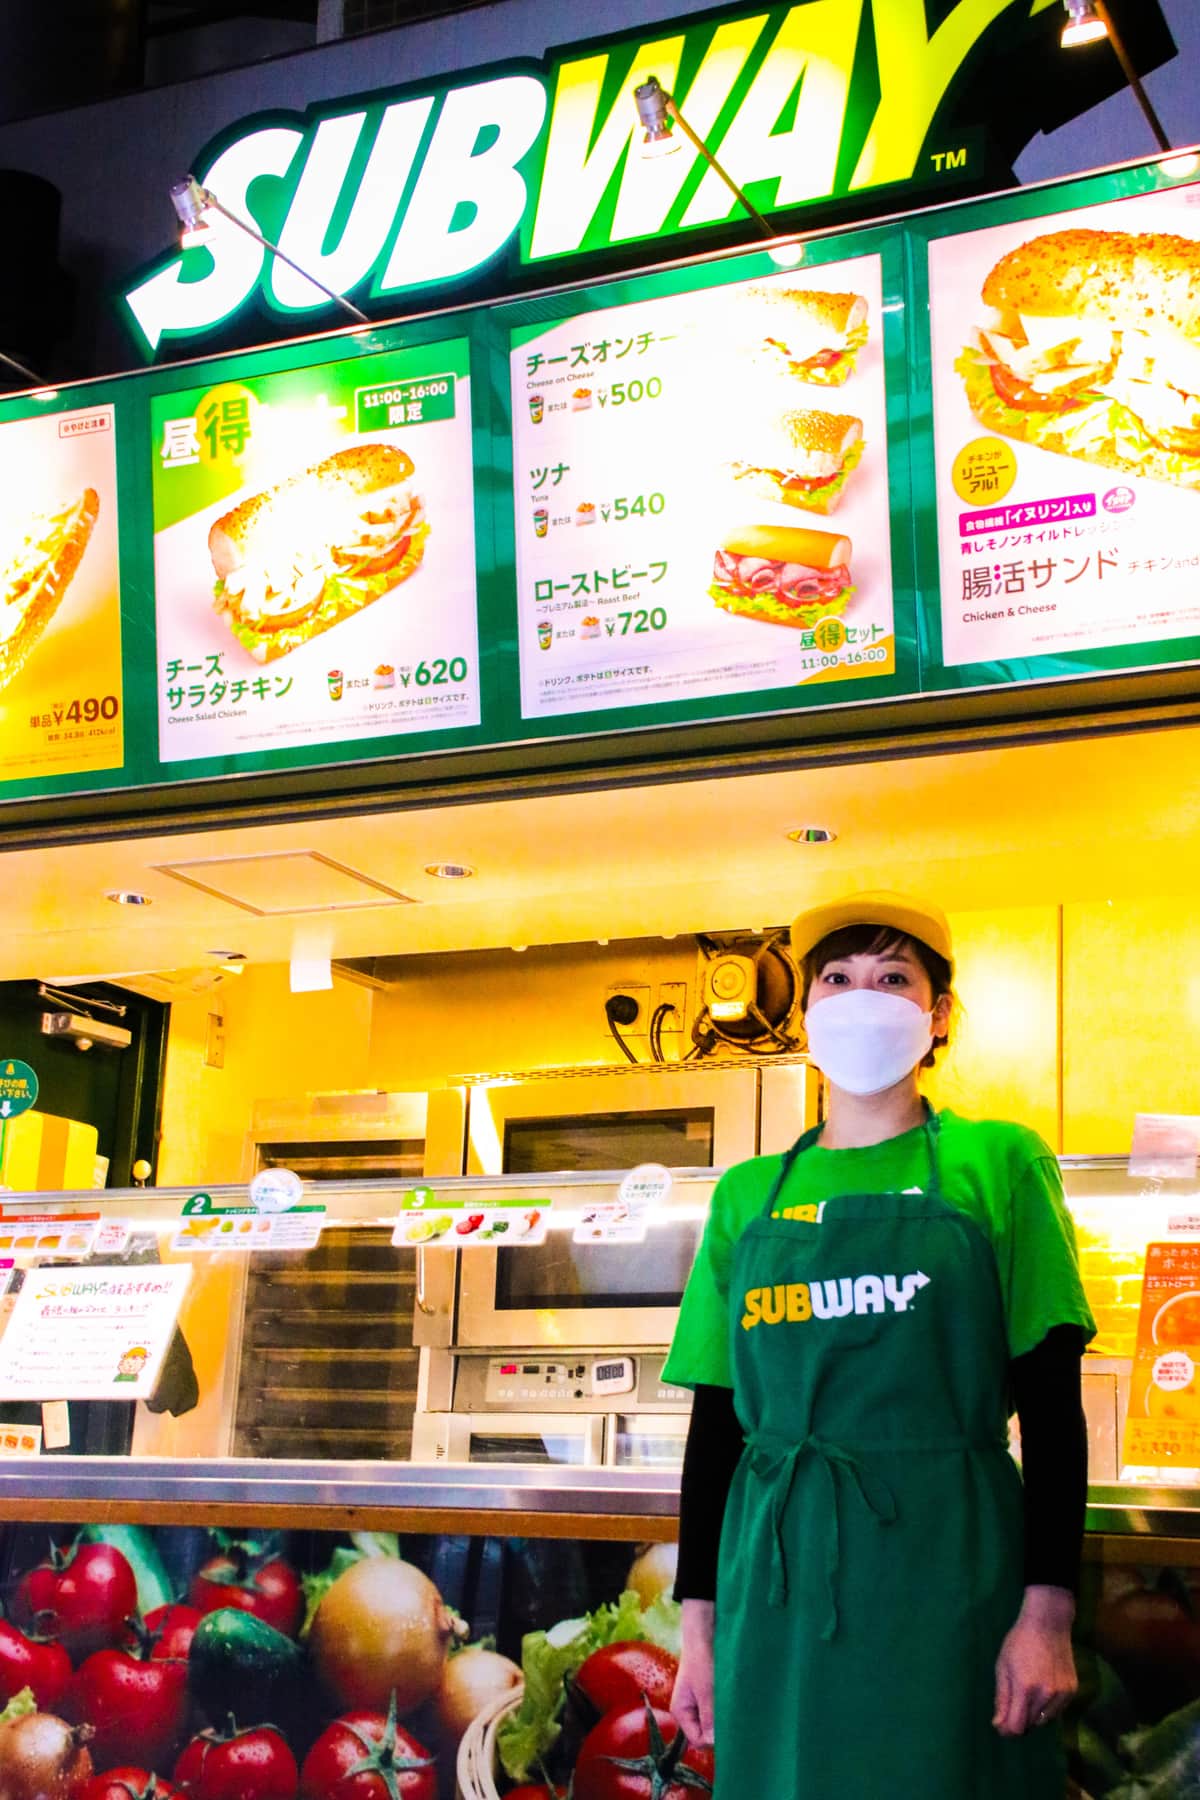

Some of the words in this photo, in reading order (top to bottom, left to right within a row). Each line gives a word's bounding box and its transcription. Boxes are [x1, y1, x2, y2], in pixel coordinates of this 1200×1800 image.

[125, 0, 1058, 350] SUBWAY
[930, 148, 967, 172] TM
[526, 379, 554, 390] Cheese
[555, 376, 566, 384] on
[566, 371, 595, 382] Cheese
[597, 376, 663, 408] ¥500
[388, 404, 423, 425] 限定
[530, 462, 570, 490] ツナ
[601, 492, 665, 523] ¥540
[534, 561, 668, 601] ローストビーフ
[962, 547, 1119, 600] 腸活サンド
[623, 592, 641, 601] Beef
[605, 607, 667, 637] ¥720
[962, 609, 1004, 623] Chicken
[1007, 607, 1015, 617] &
[1018, 603, 1057, 615] Cheese
[800, 623, 884, 651] 昼得セット
[166, 652, 225, 682] チーズ
[400, 656, 467, 688] ¥620
[166, 676, 293, 711] サラダチキン
[191, 1197, 206, 1213] 2
[412, 1190, 426, 1207] 3
[741, 1270, 931, 1331] SUBWAY
